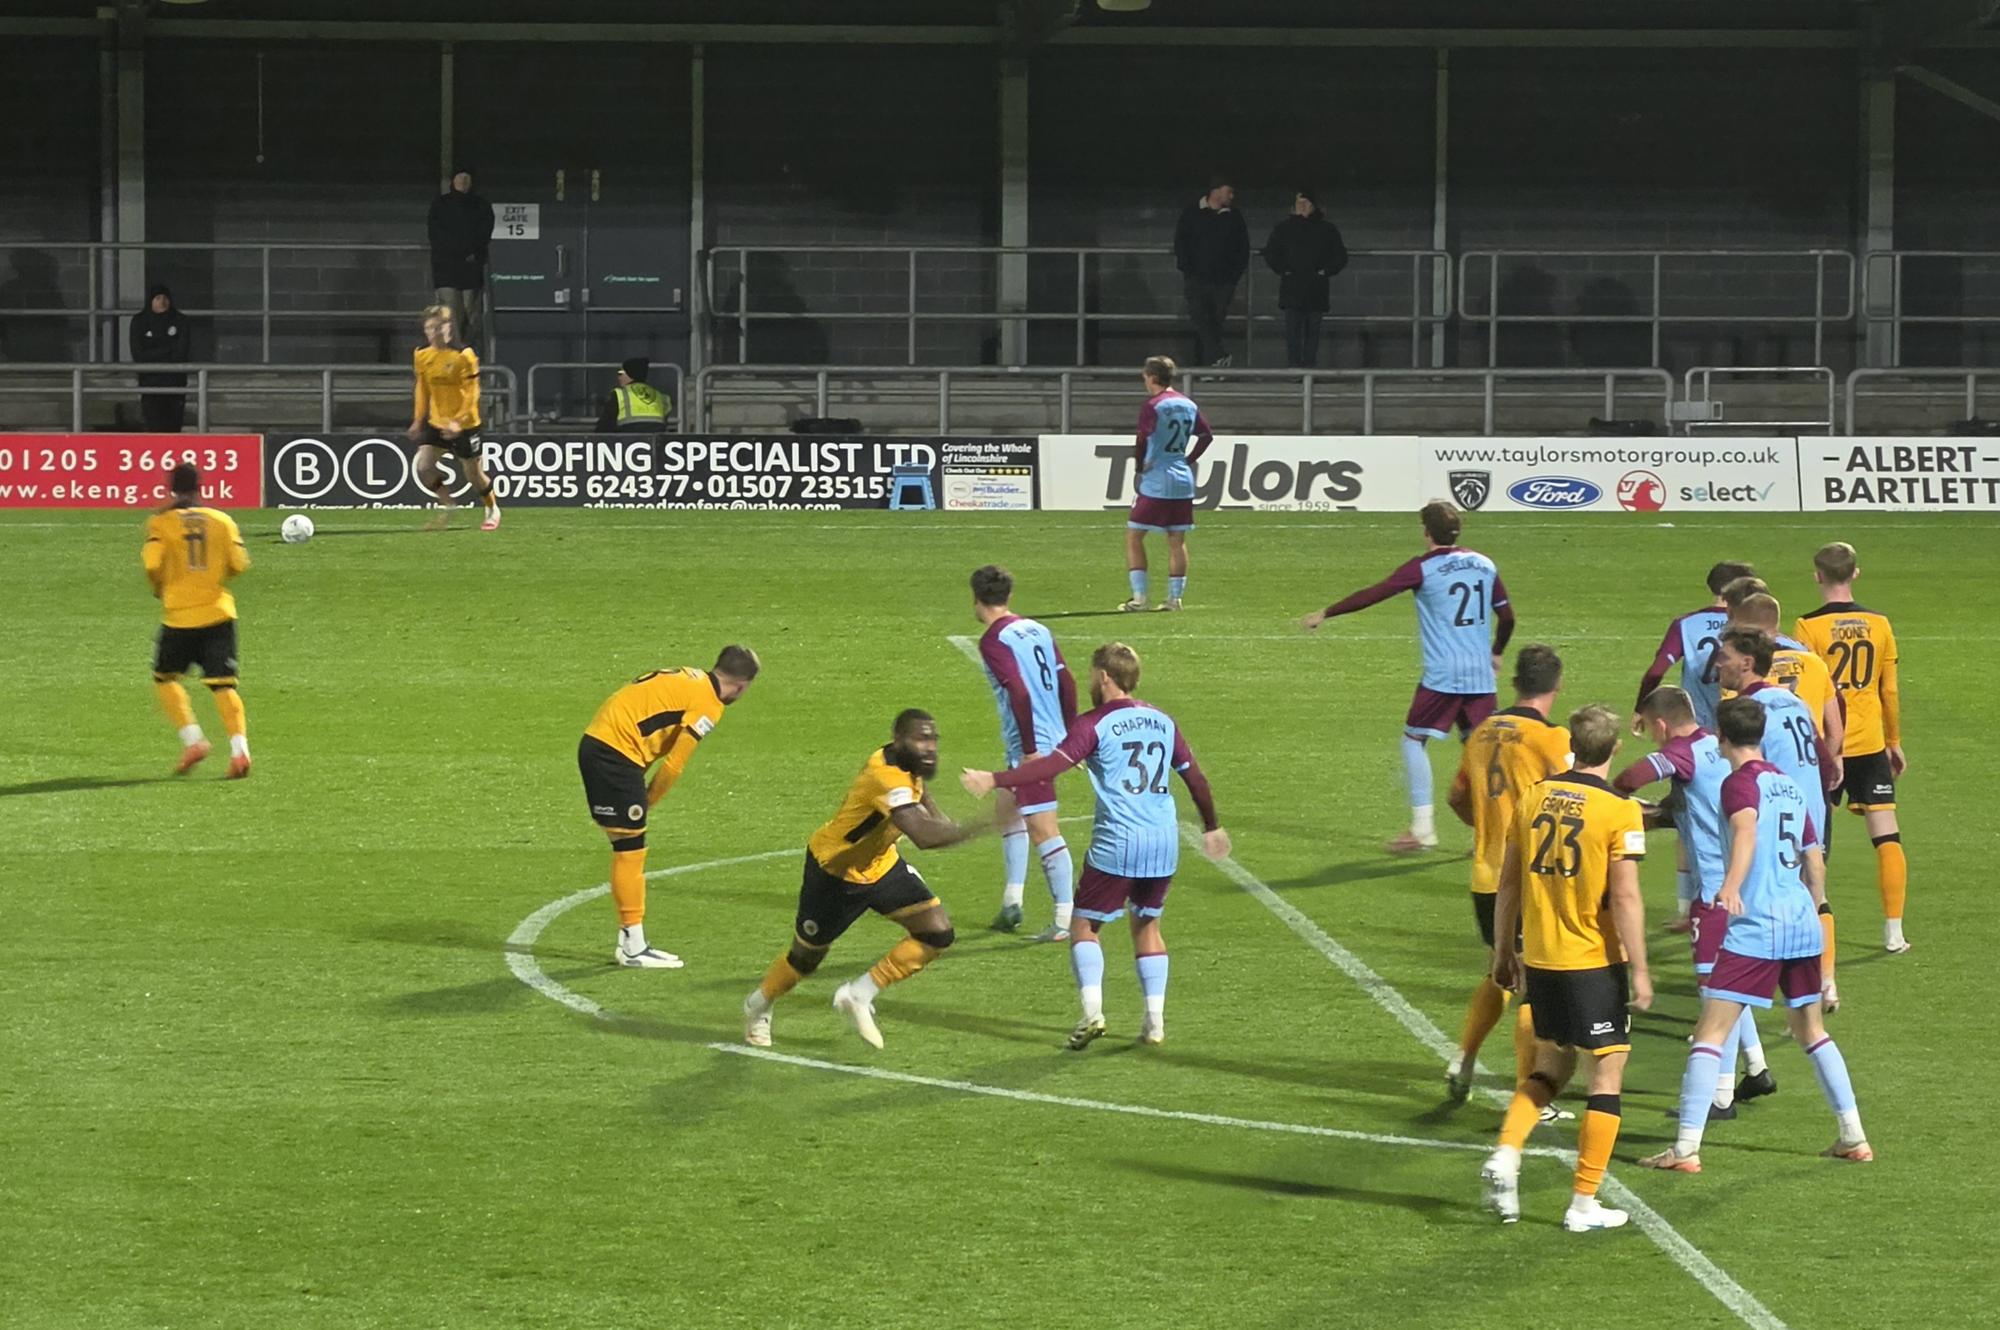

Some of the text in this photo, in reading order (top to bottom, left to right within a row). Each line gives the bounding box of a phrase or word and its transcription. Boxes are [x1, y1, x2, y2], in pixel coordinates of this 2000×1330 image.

[502, 214, 528, 222] GATE
[505, 206, 526, 214] EXIT
[507, 224, 524, 235] 15
[0, 449, 97, 471] 01205
[482, 441, 652, 472] ROOFING
[664, 441, 863, 473] SPECIALIST
[873, 443, 936, 473] LTD
[941, 443, 1032, 455] Covering the Whole
[941, 453, 1008, 464] of Lincolnshire
[1435, 446, 1780, 467] www.taylorsmotorgroup.co.uk
[1846, 446, 1977, 472] ALBERT
[295, 452, 320, 486] B
[366, 452, 386, 486] L
[1094, 443, 1364, 504] Tylors
[493, 475, 578, 498] 07555
[1523, 480, 1587, 504] Ford
[1680, 481, 1757, 501] select
[1824, 477, 2000, 504] BARTLETT
[1298, 501, 1330, 511] 1959
[1448, 579, 1485, 627] 21
[1830, 626, 1871, 640] ROONEY
[1033, 645, 1053, 691] 8
[1827, 639, 1874, 690] 20
[1112, 717, 1166, 736] CHAPMAN
[1783, 716, 1818, 767] 18
[1122, 741, 1167, 795] 32
[1542, 796, 1584, 817] GRIMES
[1530, 813, 1585, 878] 23
[1779, 812, 1801, 869] 5
